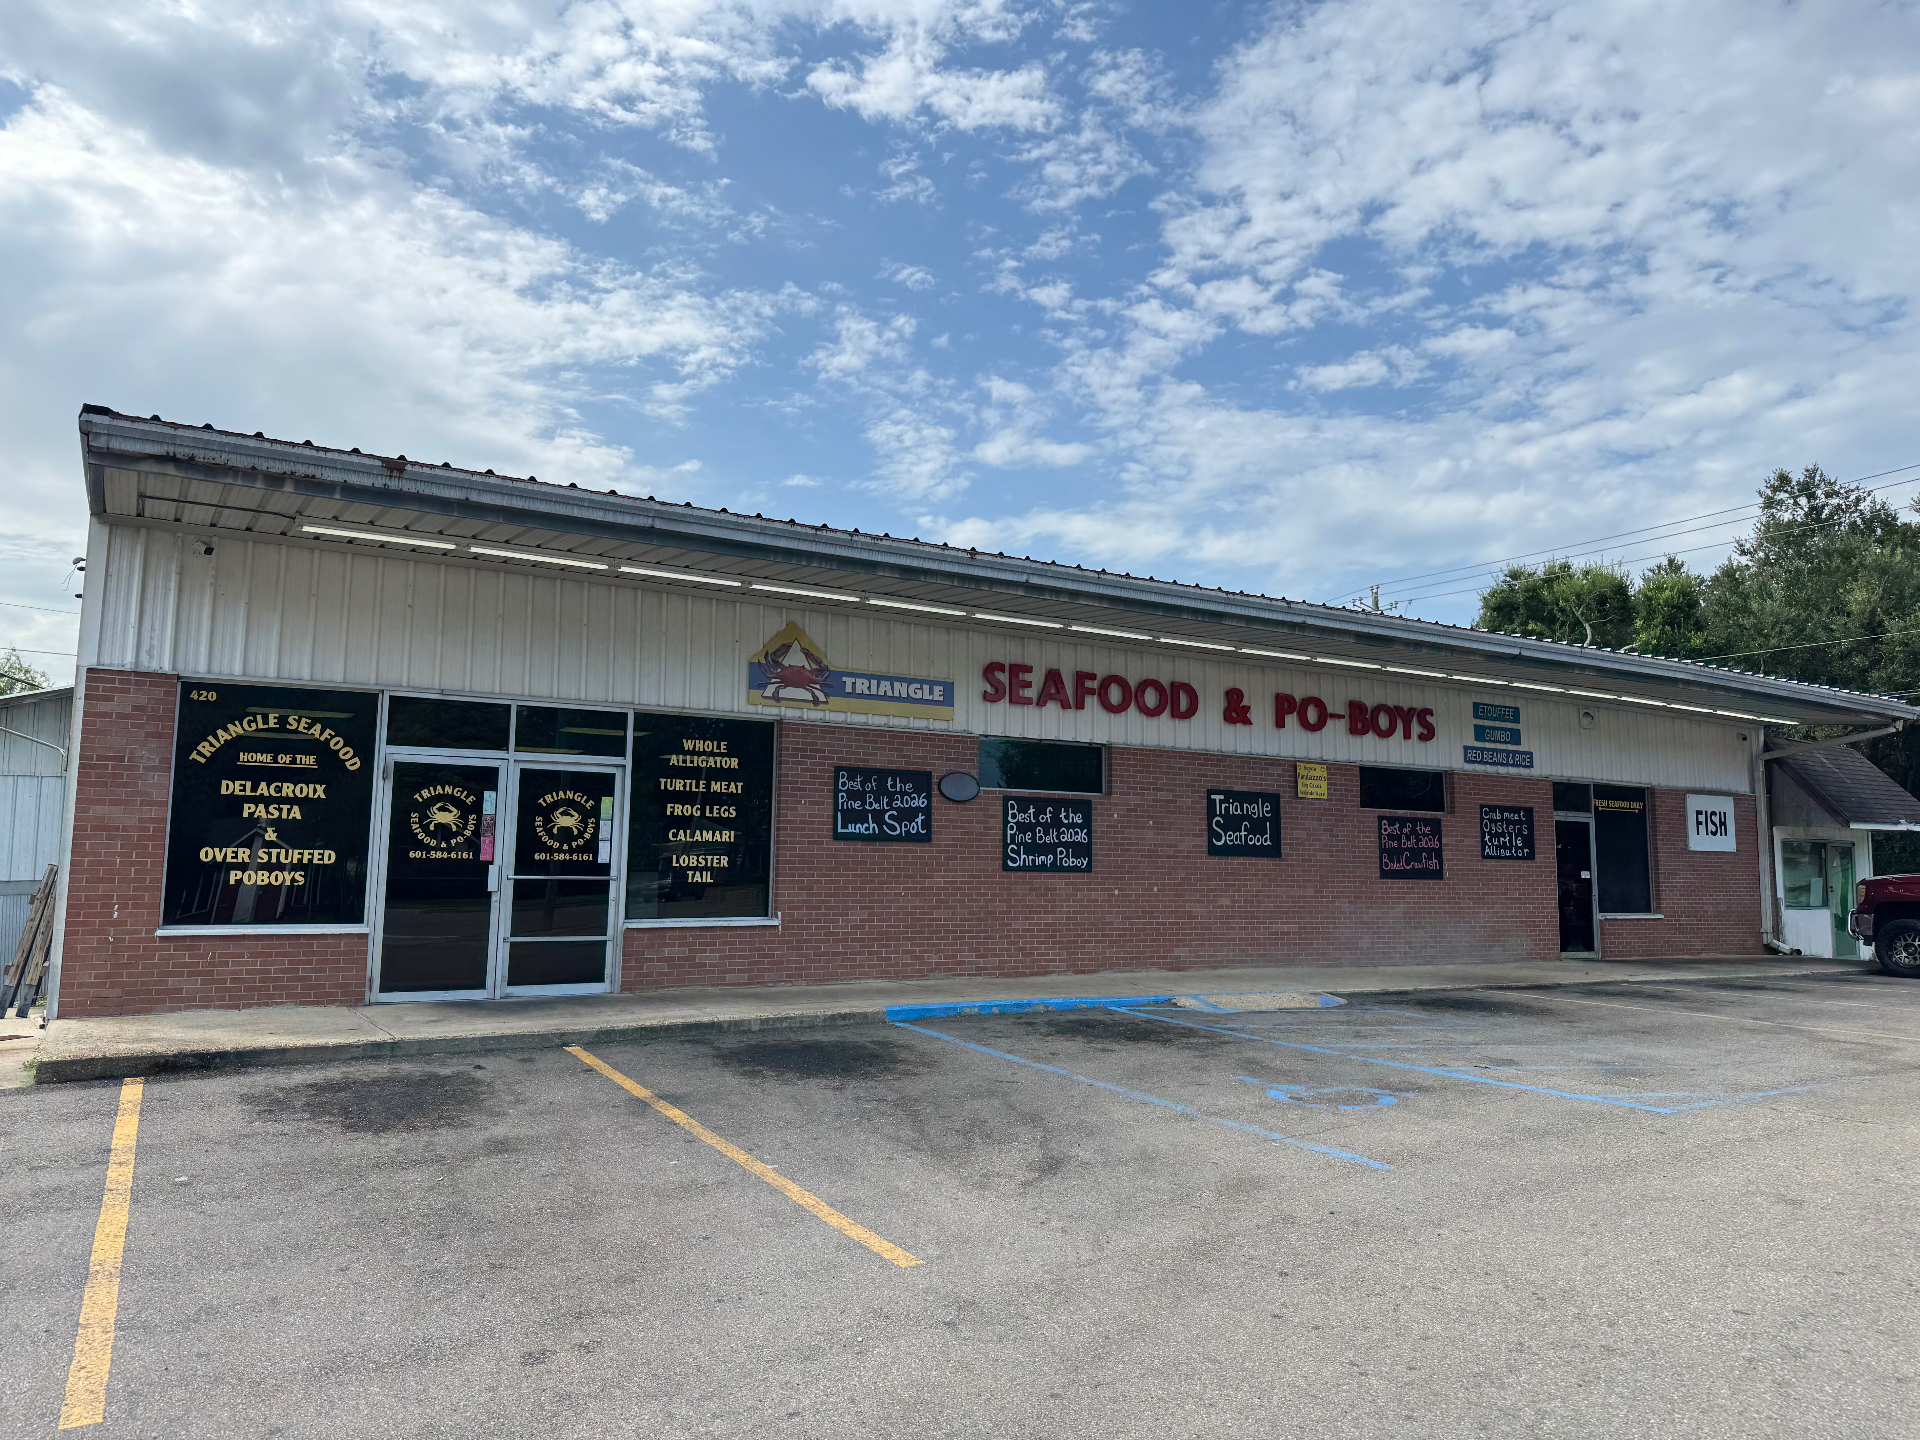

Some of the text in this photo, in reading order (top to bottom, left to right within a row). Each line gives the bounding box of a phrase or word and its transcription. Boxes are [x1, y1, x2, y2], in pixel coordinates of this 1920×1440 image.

[190, 690, 216, 701] 420
[842, 676, 944, 702] TRIANGLE
[983, 662, 1436, 742] SEAFOOD & PO-BOYS
[1479, 706, 1514, 719] ETOUFFEE
[189, 714, 361, 770] TRIANGLE SEAFOOD
[1485, 730, 1511, 742] GUMBO
[683, 739, 727, 753] WHOLE
[239, 752, 316, 765] HOME OF THE
[670, 755, 739, 769] ALLIGATOR
[1467, 750, 1531, 766] RED BEANS & RICE
[221, 780, 326, 798] DELACROIX
[659, 778, 744, 794] TURTLE MEAT
[839, 772, 914, 792] Best of the
[414, 785, 476, 805] TRIANGLE
[538, 790, 595, 809] TRIANGLE
[838, 793, 927, 810] Pine Belt 2026
[243, 803, 301, 820] PASTA
[666, 804, 736, 818] FROG LEGS
[1008, 801, 1083, 823] Best of the
[1211, 794, 1271, 818] Triangle
[1609, 800, 1629, 808] SEAFOOD
[411, 812, 437, 846] SEAFOOD
[450, 814, 476, 846] PO-BOYS
[838, 811, 926, 836] Lunch Spot
[1212, 816, 1272, 845] Seafood
[1381, 820, 1431, 834] Best of the
[1483, 820, 1528, 834] Oysters
[1696, 810, 1728, 837] FISH
[265, 828, 277, 840] &
[535, 816, 559, 849] SEAFOOD
[572, 818, 595, 848] PO-BOYS
[669, 829, 735, 842] CALAMARI
[1007, 823, 1088, 843] Pine Belt 2026
[1382, 835, 1440, 848] Pine Belt 2026
[200, 847, 336, 864] OVER STUFFED
[409, 851, 473, 859] 601-584-6161
[1007, 845, 1088, 868] Shrimp Poboy
[1485, 845, 1529, 856] Alligator
[672, 854, 728, 868] LOBSTER
[229, 870, 305, 885] POBOYS
[687, 871, 713, 883] TAIL
